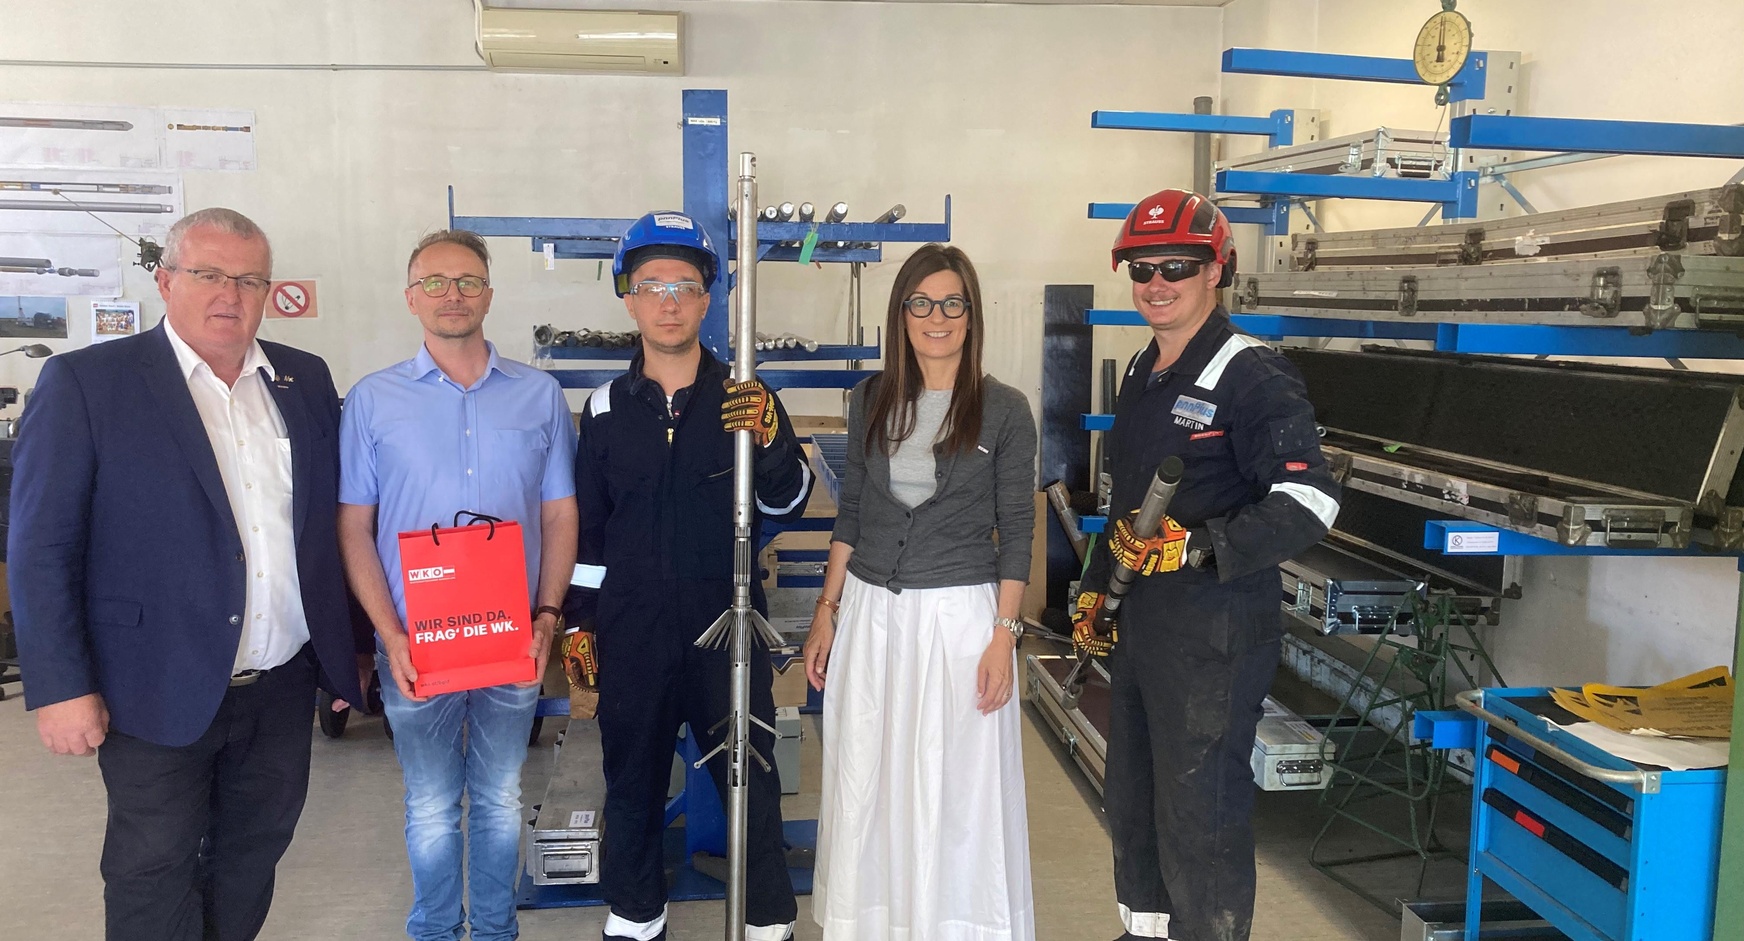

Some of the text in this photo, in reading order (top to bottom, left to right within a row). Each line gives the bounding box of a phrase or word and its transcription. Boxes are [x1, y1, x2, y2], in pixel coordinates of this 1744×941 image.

[1173, 416, 1205, 431] MARTIN
[409, 567, 443, 580] WKO
[415, 610, 511, 631] WIR SIND DA.
[463, 624, 488, 638] DIE
[491, 620, 519, 634] WK.
